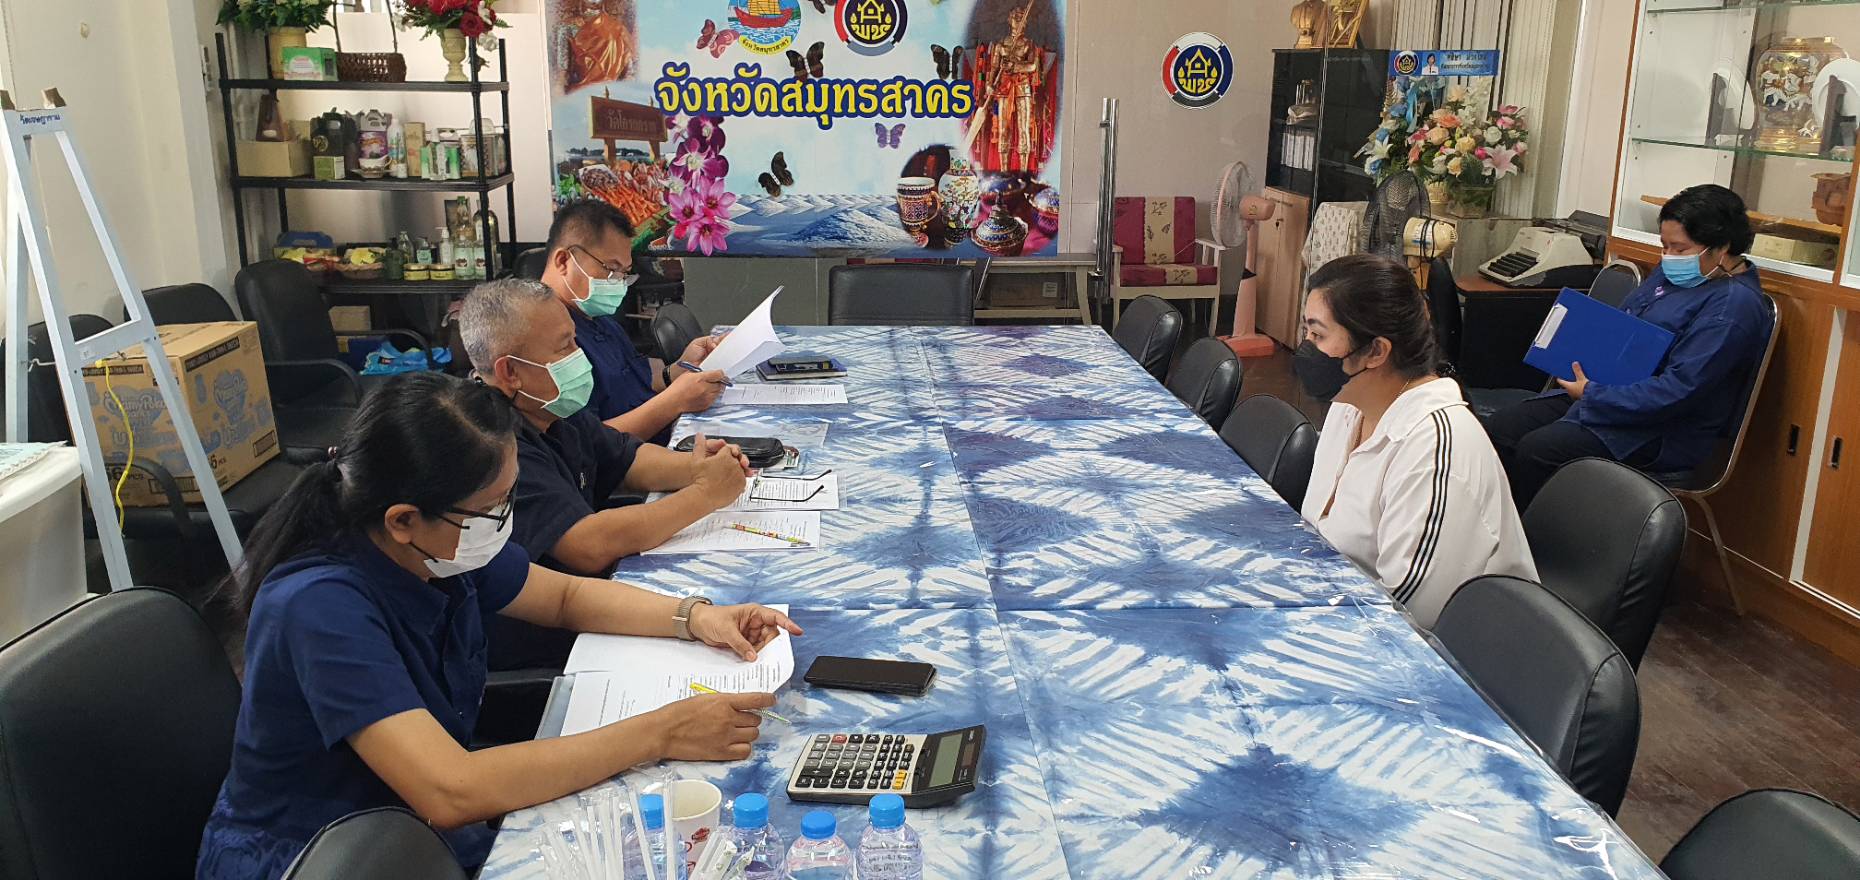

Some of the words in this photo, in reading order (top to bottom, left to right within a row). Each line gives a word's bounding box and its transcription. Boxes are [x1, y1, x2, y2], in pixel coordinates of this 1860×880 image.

[656, 64, 974, 127] จังหวัดสมุทรสาคร
